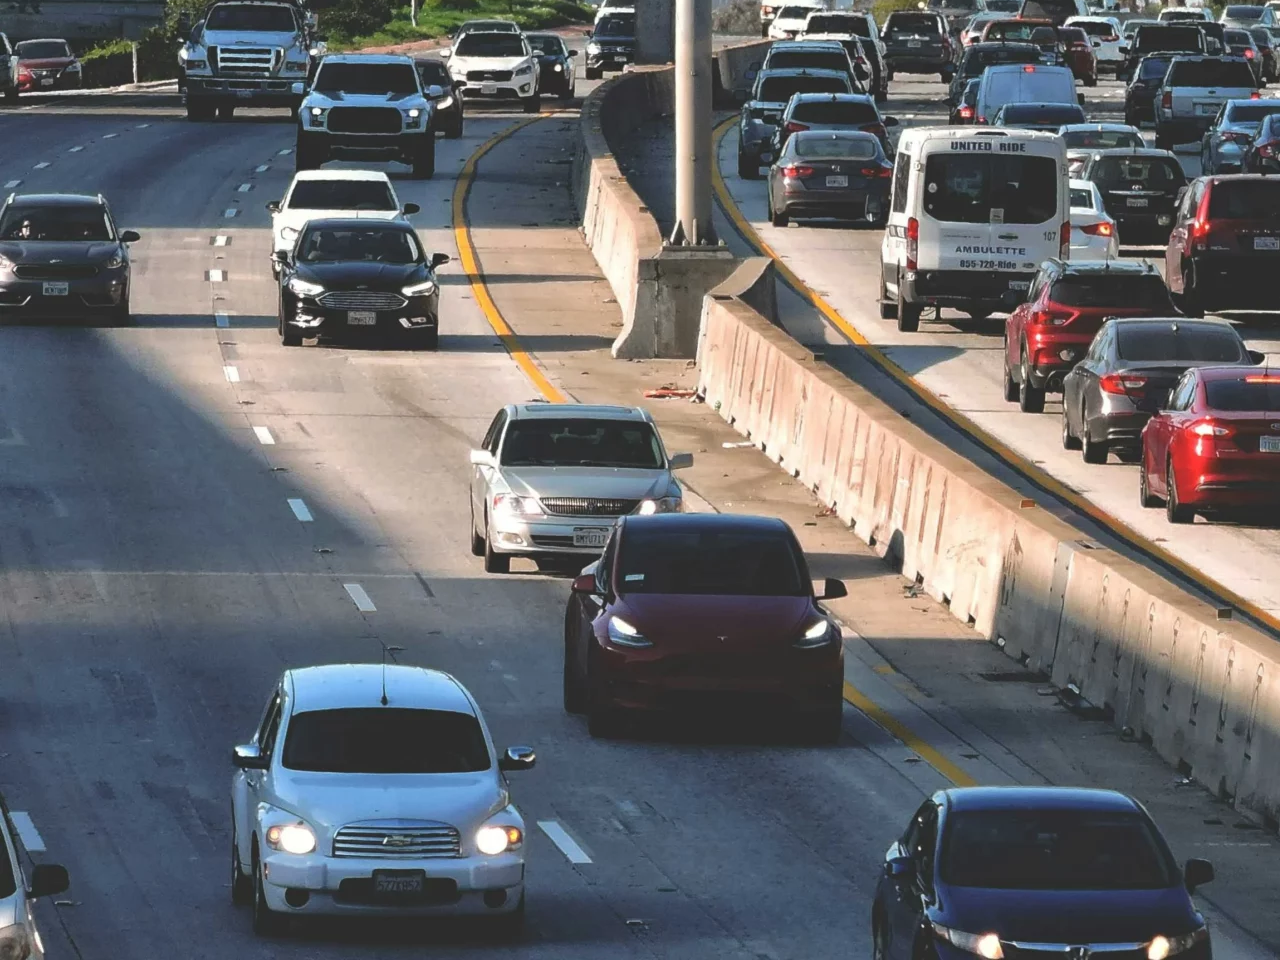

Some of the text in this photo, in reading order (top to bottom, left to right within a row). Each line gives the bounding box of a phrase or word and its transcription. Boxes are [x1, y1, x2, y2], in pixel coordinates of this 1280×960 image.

[950, 141, 1026, 152] UNITED RIDE
[1043, 231, 1056, 242] 107
[955, 245, 1026, 256] AMBULETTE
